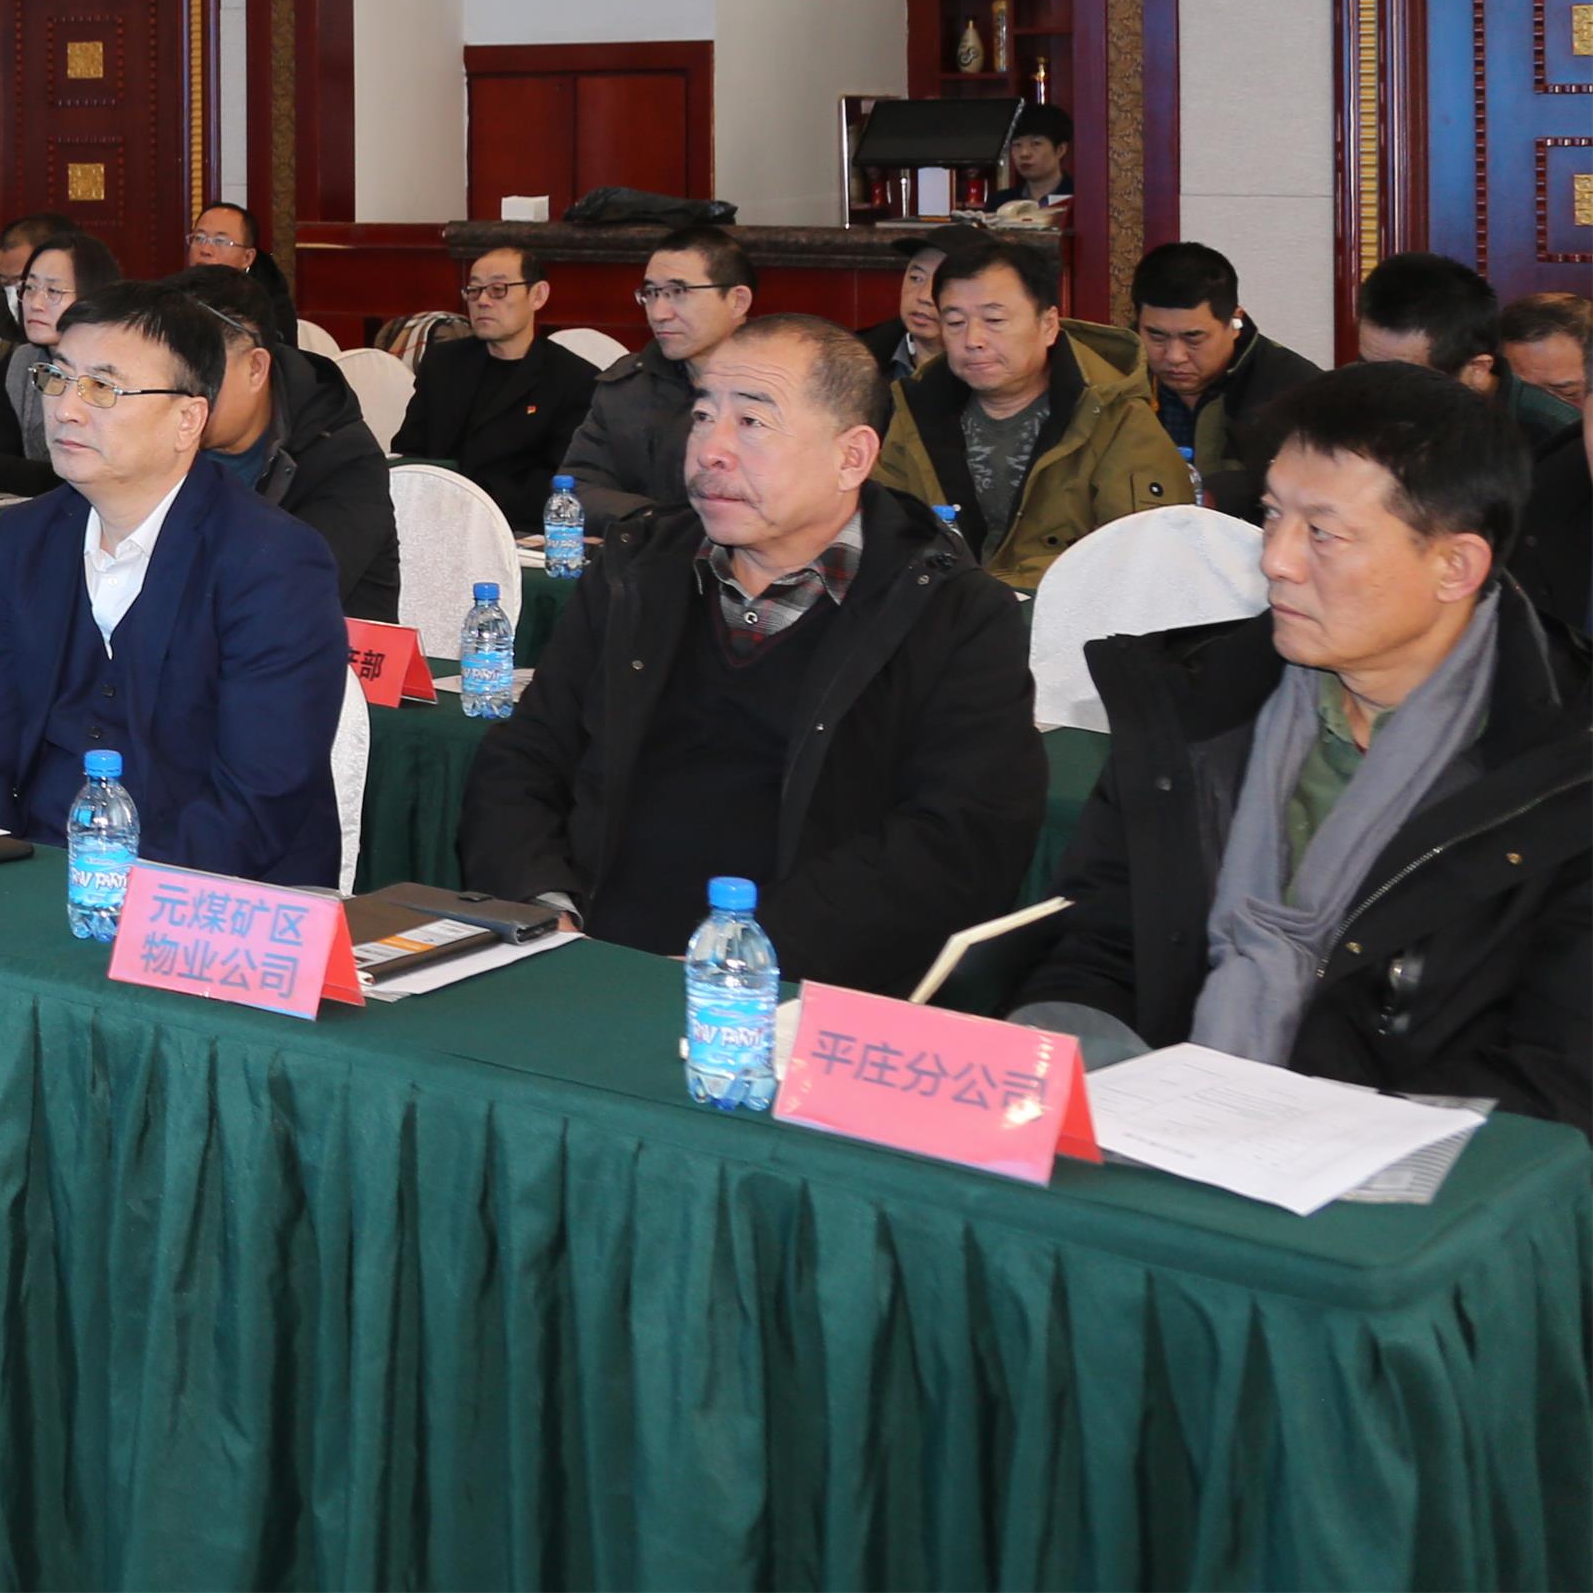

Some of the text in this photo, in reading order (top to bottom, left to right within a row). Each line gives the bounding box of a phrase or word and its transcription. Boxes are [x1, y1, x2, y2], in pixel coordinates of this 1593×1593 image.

[149, 883, 310, 947] 元煤矿区
[141, 931, 300, 1000] 物业公司
[811, 1029, 1049, 1121] 平庄分公司
